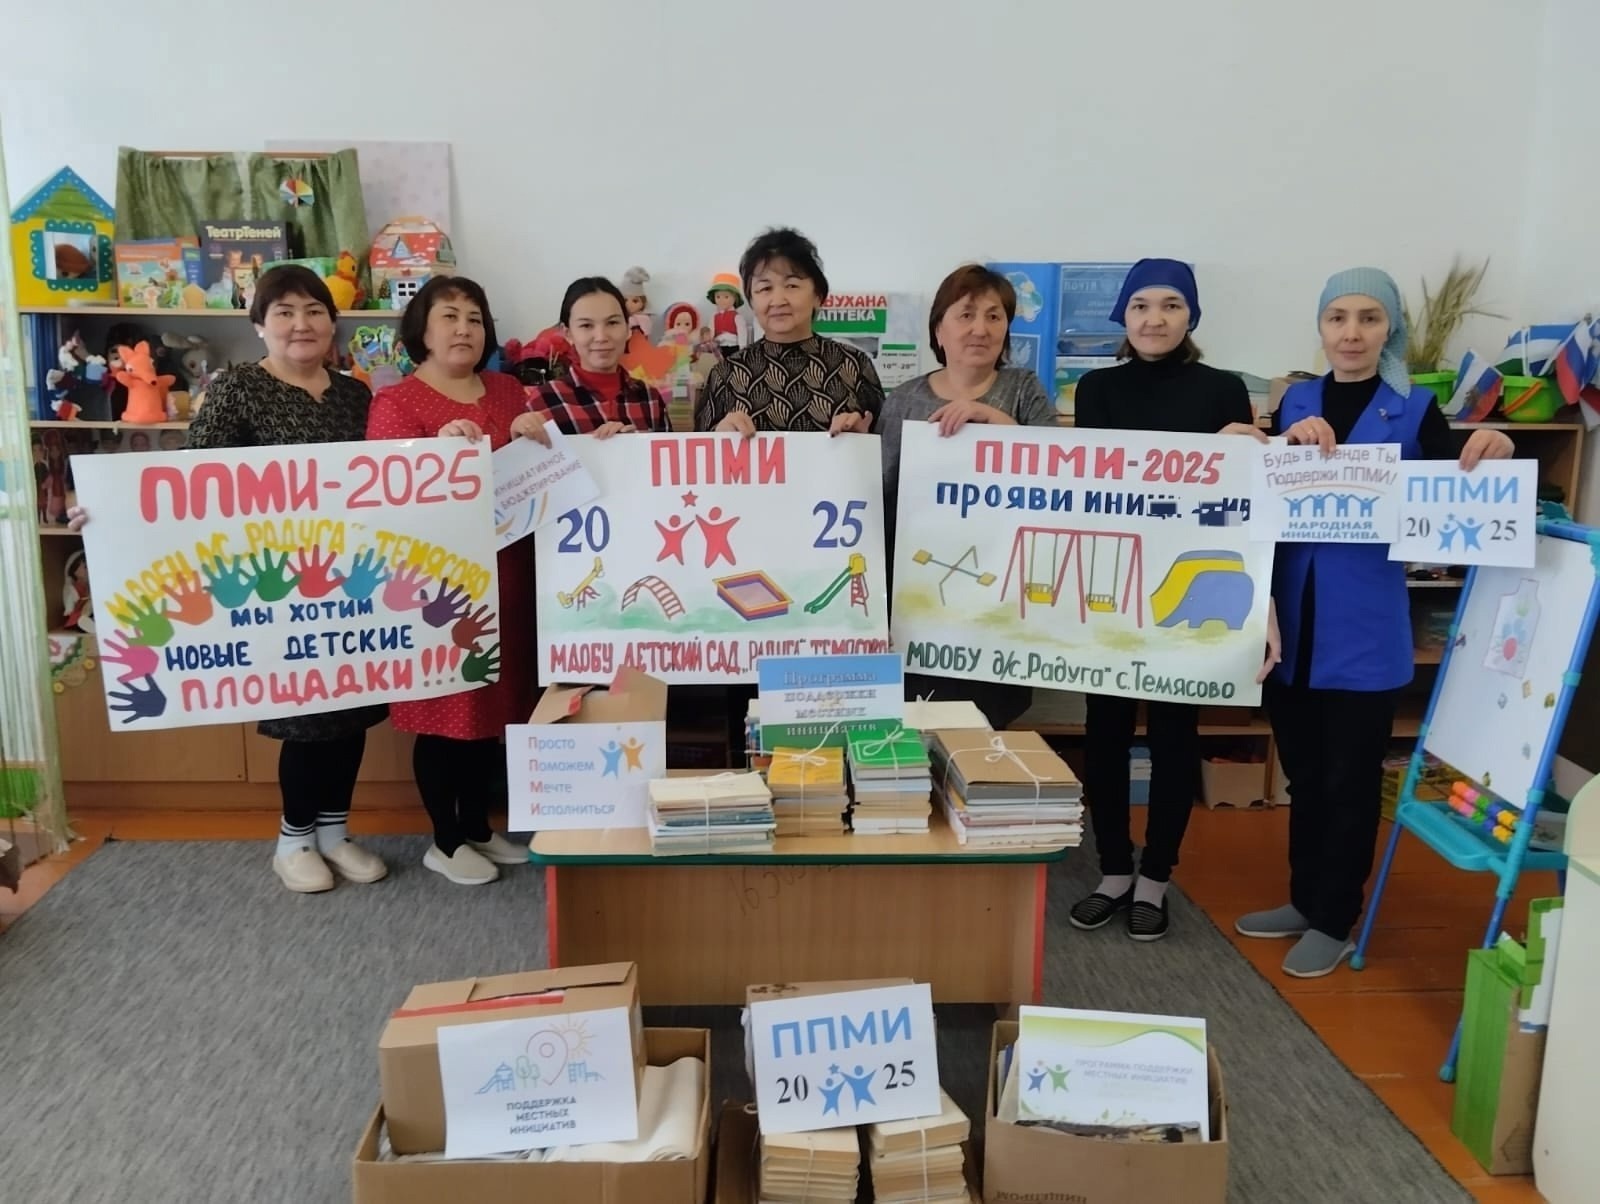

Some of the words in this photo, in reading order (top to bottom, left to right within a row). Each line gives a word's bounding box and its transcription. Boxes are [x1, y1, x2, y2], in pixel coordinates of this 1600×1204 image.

[815, 310, 877, 322] АПТЕКА
[650, 436, 786, 487] ППМИ
[974, 440, 1226, 485] ППМИ-2025
[1263, 451, 1299, 468] Будь
[1305, 449, 1313, 462] в
[1376, 446, 1397, 464] Ты
[494, 451, 567, 497] ИНИЦИАТИВНОЕ
[1266, 467, 1338, 488] Поддержи
[1343, 465, 1398, 486] ППМИ!
[139, 449, 482, 523] ППМИ-2025
[1407, 476, 1518, 504] ППМИ
[557, 505, 610, 553] 20
[812, 500, 868, 549] 25
[1281, 530, 1380, 541] ИНИЦИАТИВА
[1288, 521, 1373, 531] НАРОДНАЯ
[1405, 516, 1431, 537] 20
[1490, 519, 1518, 541] 25
[289, 597, 374, 623] ХОТИМ
[165, 641, 253, 673] НОВЫЕ
[283, 624, 415, 662] ДЕТСКИЕ
[550, 642, 614, 674] МДОБУ
[783, 671, 877, 689] Программа
[527, 736, 576, 754] Просто
[528, 757, 595, 773] Поможем
[530, 781, 573, 795] Мечте
[530, 802, 616, 817] Исполниться
[771, 1006, 912, 1059] ППМИ
[1075, 1058, 1131, 1071] ПРОГРАММА
[1134, 1063, 1193, 1075] ПОДДЕРЖКИ
[775, 1074, 809, 1105] 20
[882, 1060, 917, 1091] 25
[506, 1096, 577, 1112] ПОДДЕРЖКА
[515, 1108, 570, 1122] МЕСТНЫХ
[509, 1119, 577, 1136] ИНИЦИАТИВ
